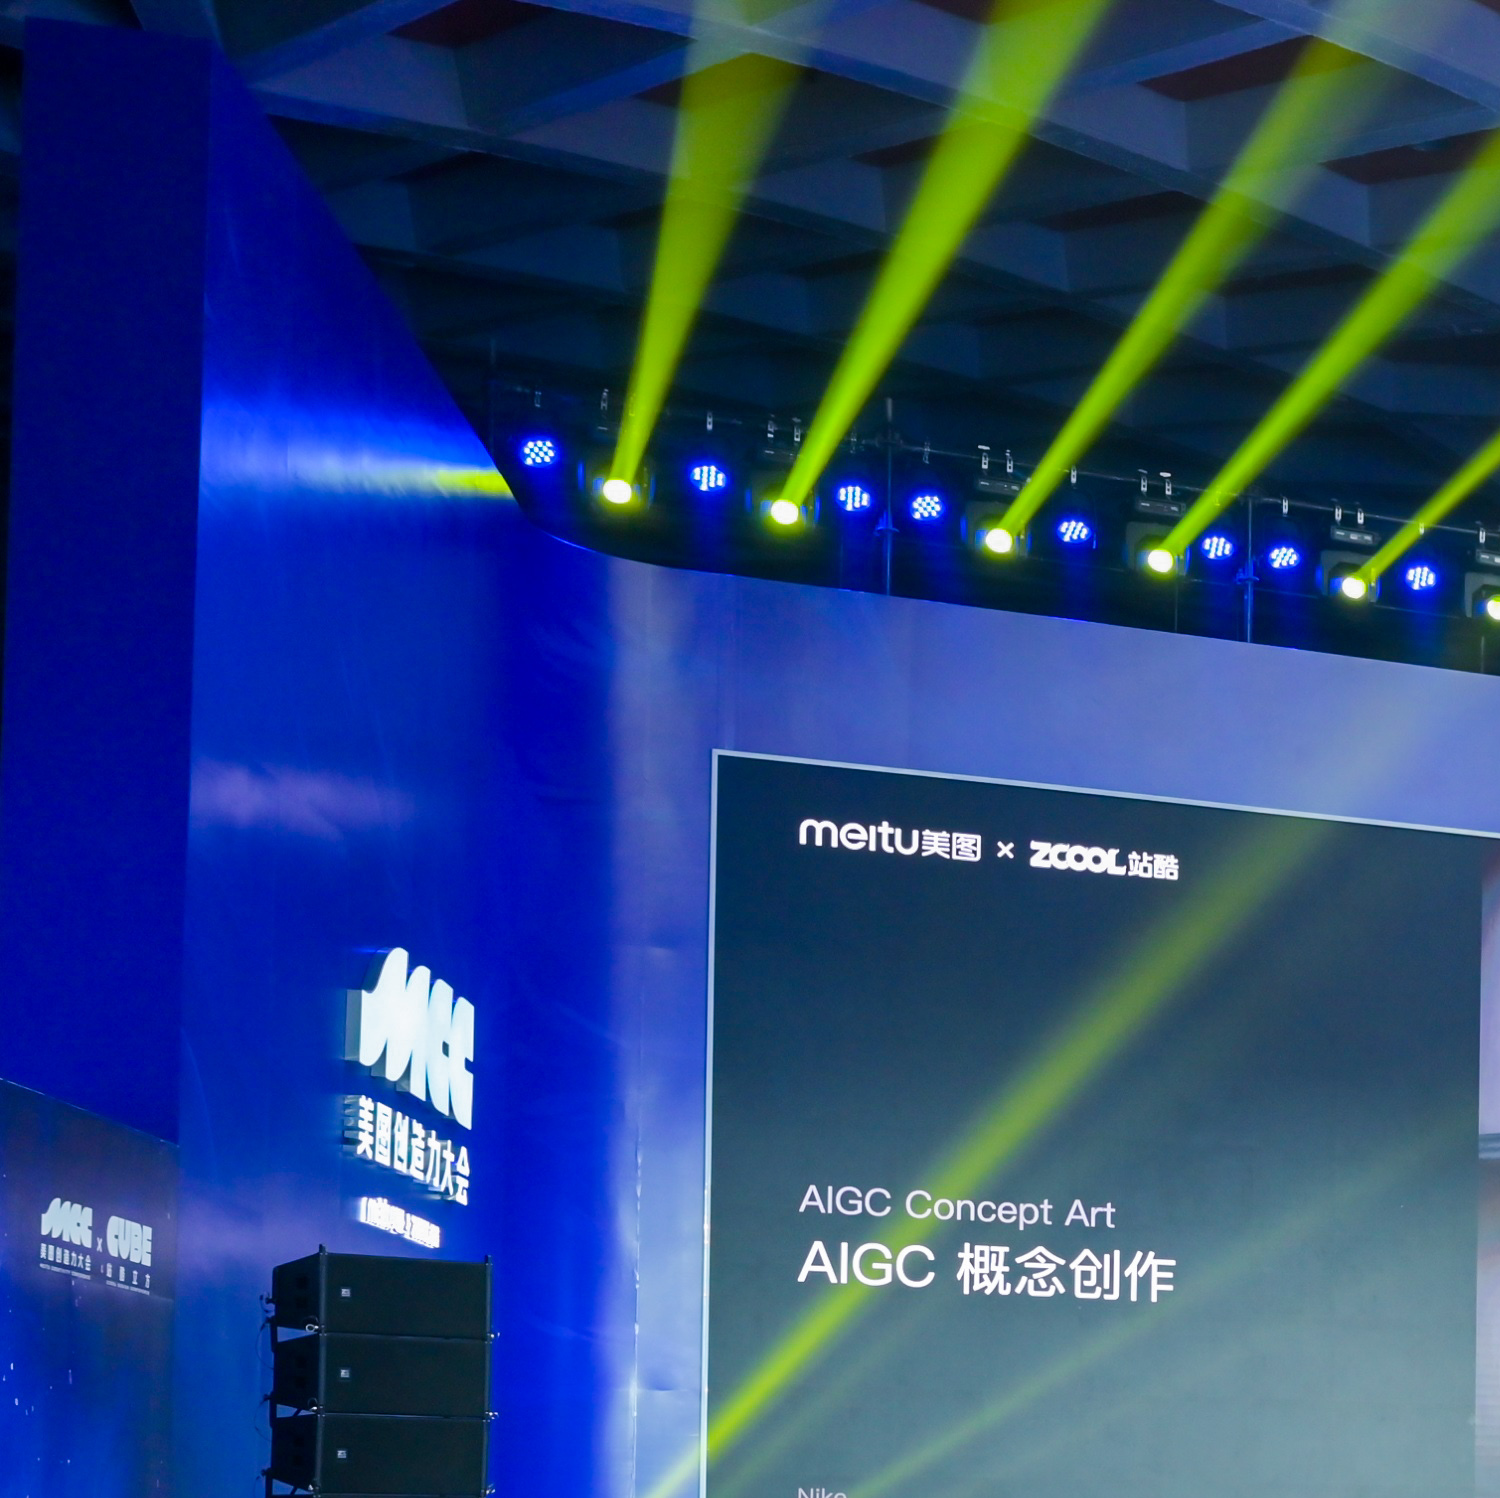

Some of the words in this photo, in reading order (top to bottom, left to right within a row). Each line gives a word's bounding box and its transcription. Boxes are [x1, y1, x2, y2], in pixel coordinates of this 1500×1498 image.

[799, 1184, 892, 1217] AIGC
[905, 1189, 1053, 1231] Concept
[1064, 1199, 1116, 1229] Art
[106, 1215, 153, 1267] CUBE
[797, 1240, 935, 1288] AIGC
[956, 1242, 1177, 1303] 概念创作
